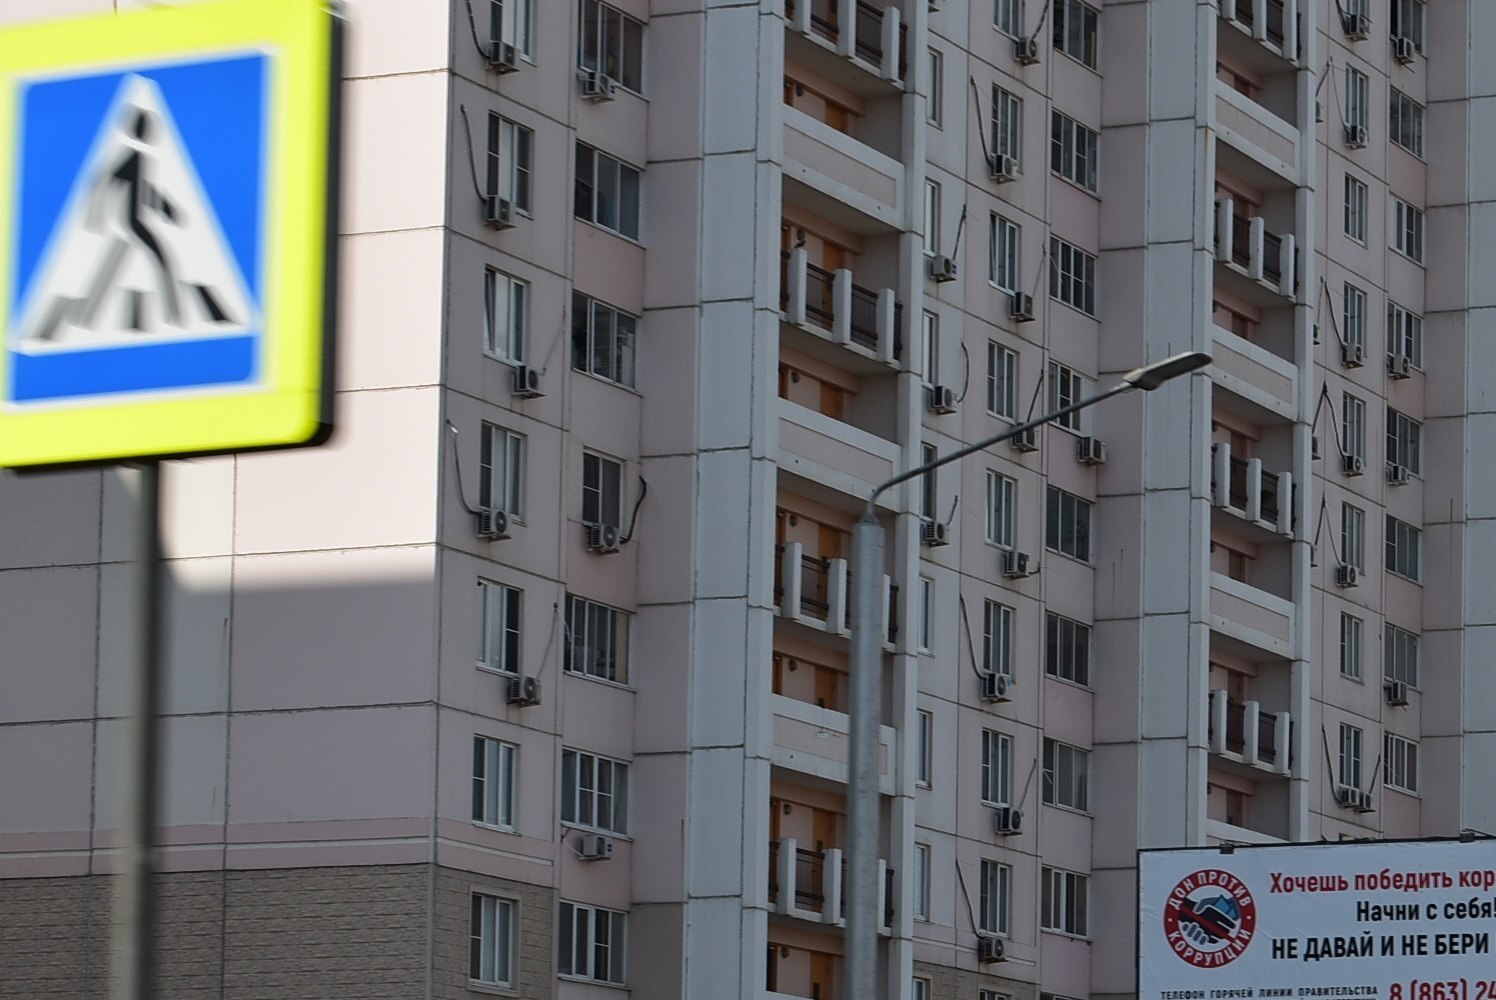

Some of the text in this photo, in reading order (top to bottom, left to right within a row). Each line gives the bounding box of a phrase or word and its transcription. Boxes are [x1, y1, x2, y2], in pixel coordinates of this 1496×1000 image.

[1168, 871, 1252, 911] ДОН ПРОТИВ
[1269, 872, 1349, 893] Хочешь
[1354, 868, 1453, 892] победить
[1356, 900, 1420, 922] Начни
[1426, 903, 1438, 920] с
[1168, 929, 1252, 966] КОРРУПЦИИ
[1272, 938, 1298, 960] НЕ
[1303, 930, 1374, 962] ДАВАЙ
[1381, 935, 1394, 957] И
[1401, 934, 1428, 956] НЕ
[1435, 932, 1489, 955] БЕРИ
[1160, 986, 1378, 1000] ТЕЛЕФОН ГОРЯЧЕЙ ЛИНИИ ПРАВИТЕЛЬСТВА
